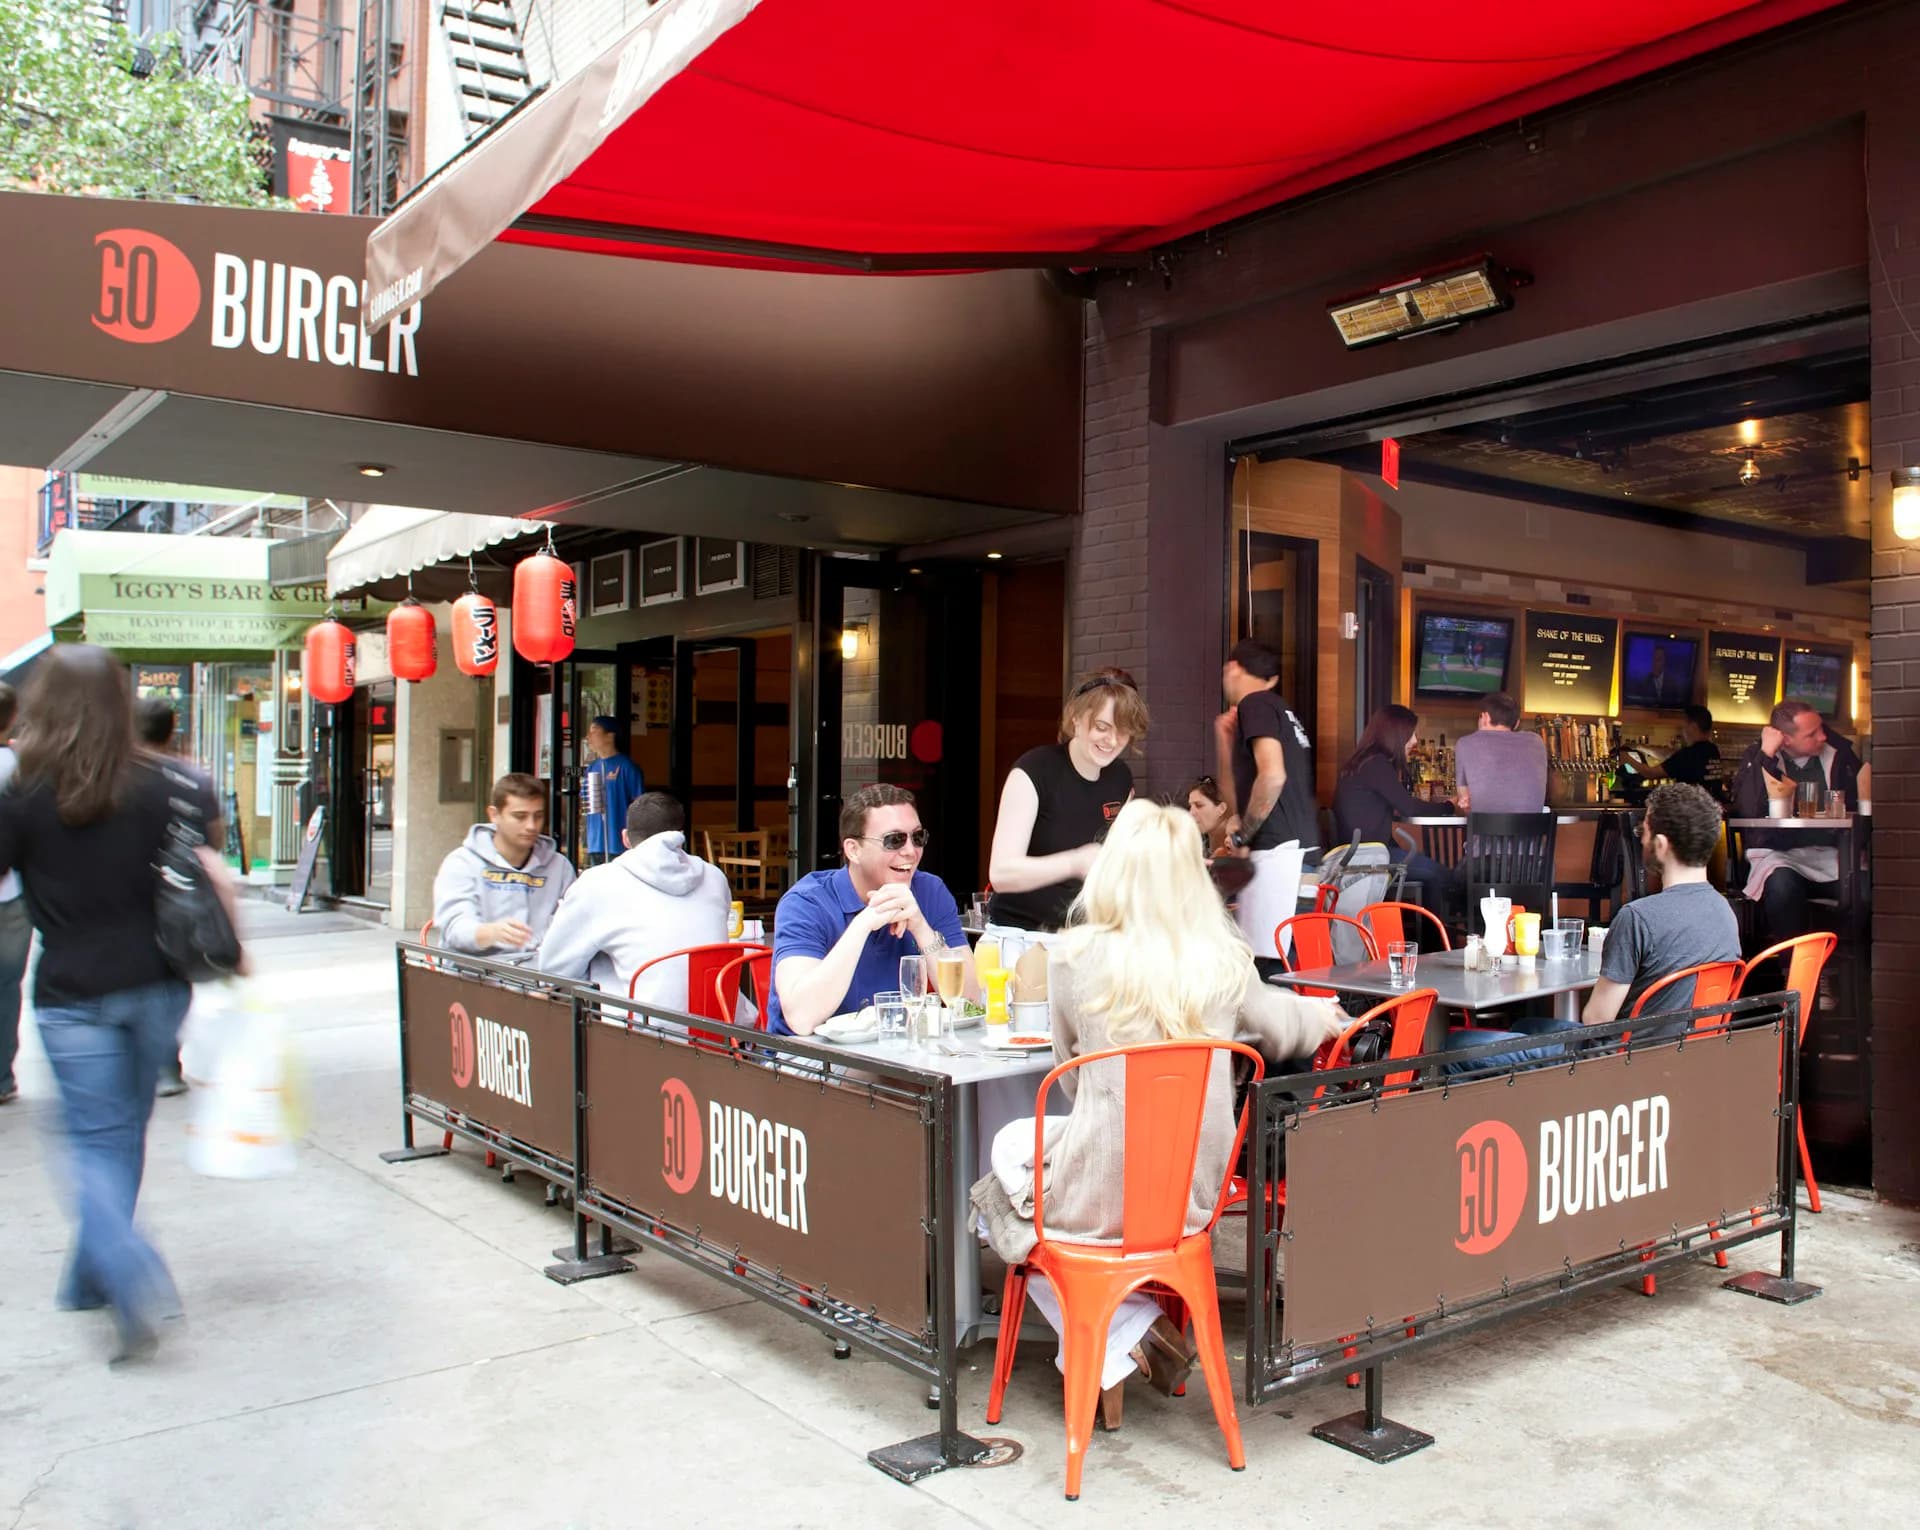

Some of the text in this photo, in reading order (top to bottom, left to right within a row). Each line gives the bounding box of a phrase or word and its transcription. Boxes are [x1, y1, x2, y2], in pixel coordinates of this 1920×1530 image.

[93, 237, 158, 331] GO
[115, 581, 330, 603] IGGY'S BAR & GR
[250, 618, 288, 631] DAYS
[1536, 627, 1559, 640] SHAKE
[1559, 630, 1570, 641] OF
[1571, 631, 1584, 642] THE
[476, 1016, 532, 1108] BURGER
[709, 1100, 809, 1235] BURGER
[1456, 1095, 1670, 1244] GO BURGER
